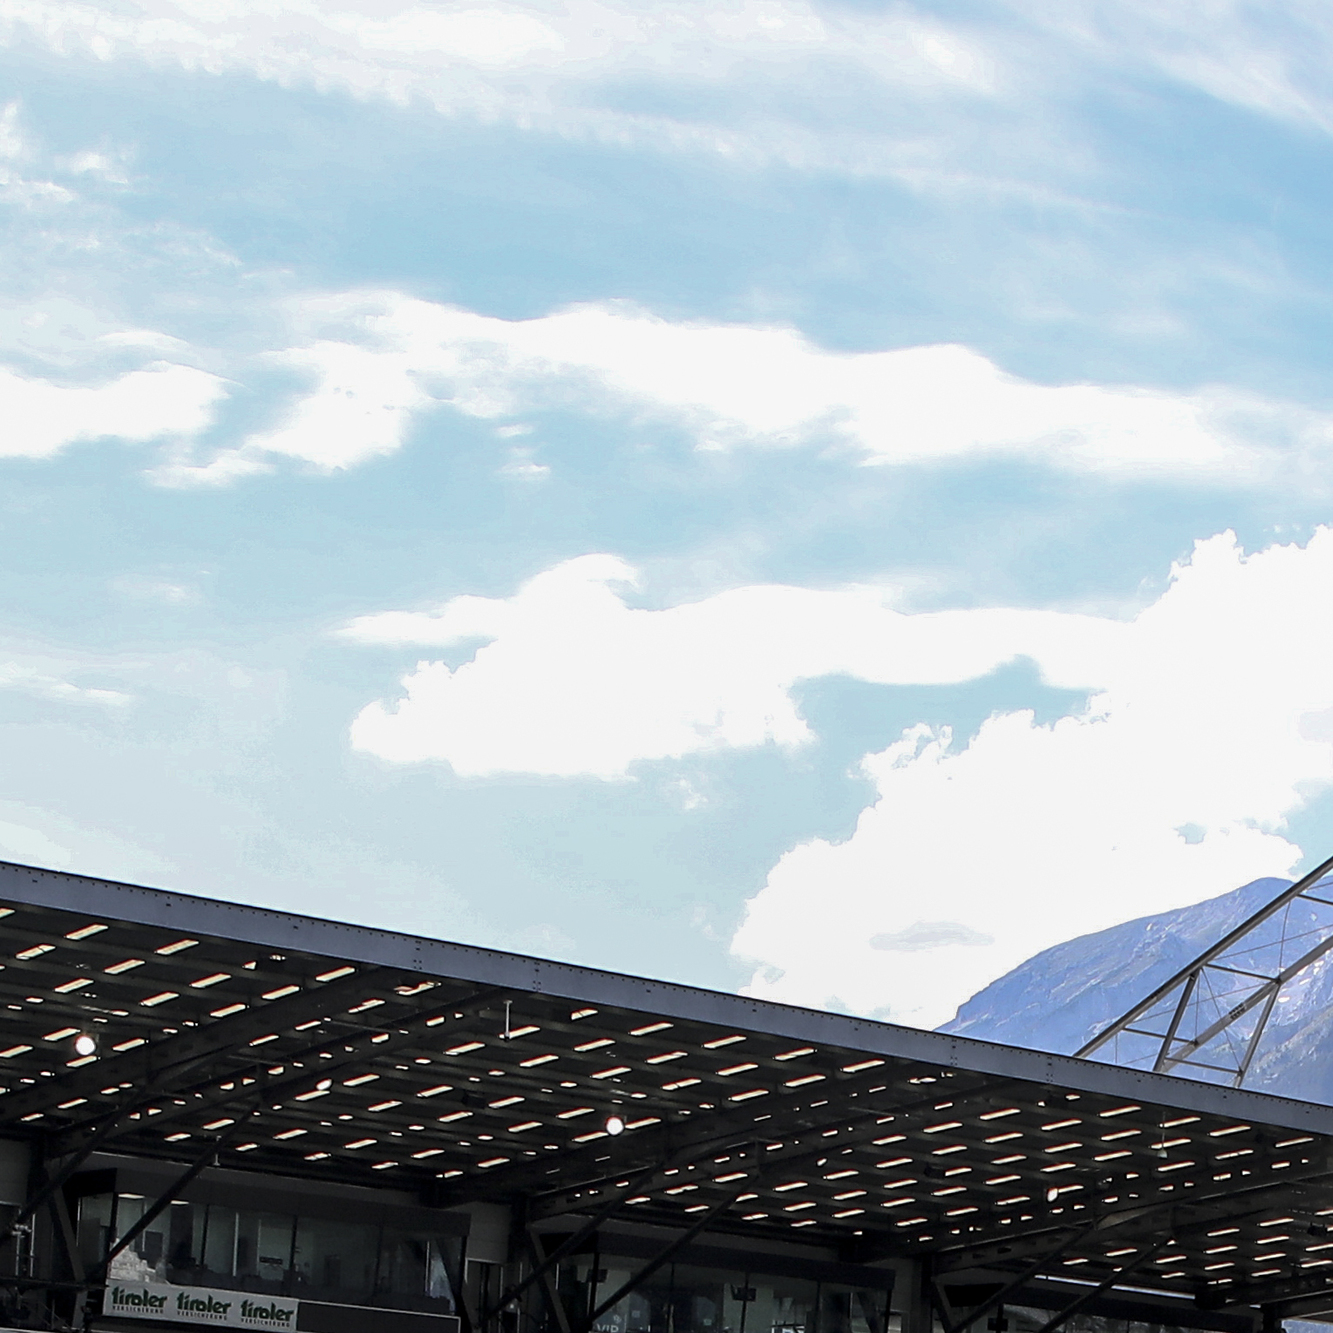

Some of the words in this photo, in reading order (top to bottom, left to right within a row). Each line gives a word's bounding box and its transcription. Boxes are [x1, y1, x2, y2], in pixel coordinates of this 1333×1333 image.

[112, 1286, 168, 1308] tiroler
[177, 1291, 232, 1314] tiroler
[112, 1306, 164, 1314] VERSICHERUNG
[177, 1311, 228, 1321] VERSICHERUNG
[241, 1299, 295, 1322] tiroler
[240, 1318, 290, 1328] VERSICHERUNG
